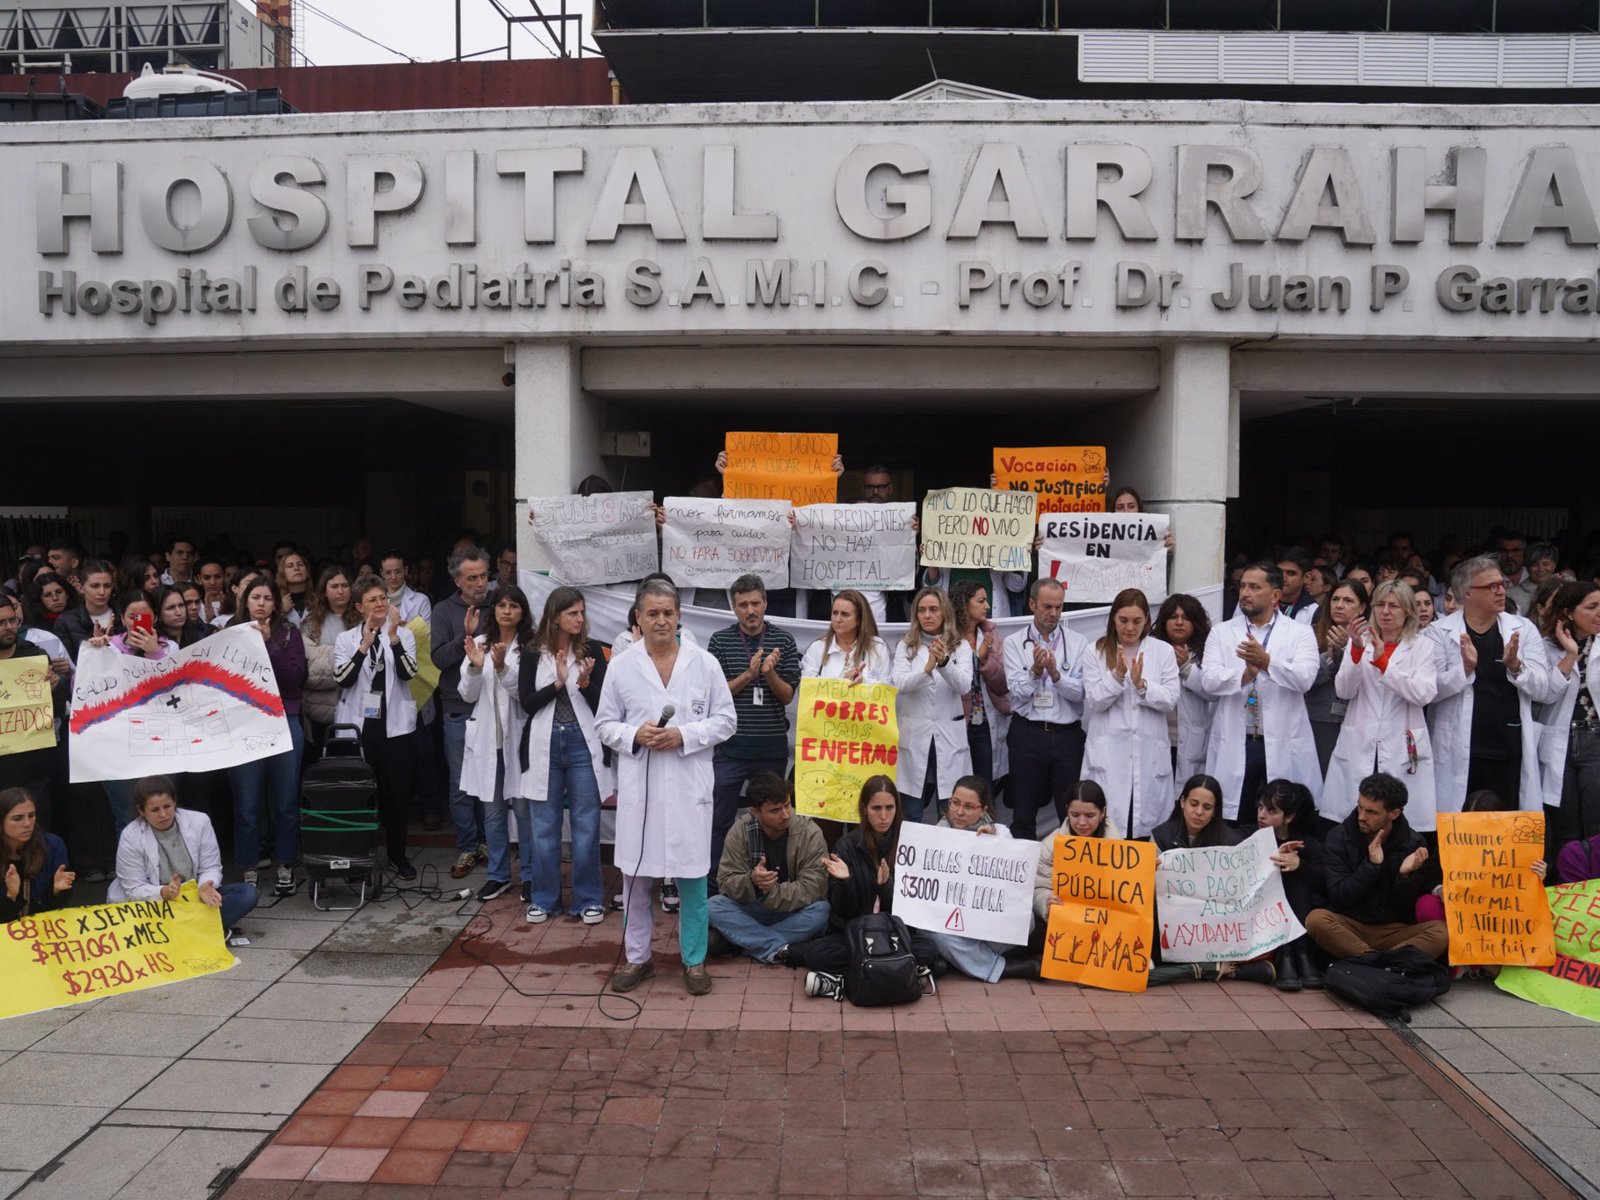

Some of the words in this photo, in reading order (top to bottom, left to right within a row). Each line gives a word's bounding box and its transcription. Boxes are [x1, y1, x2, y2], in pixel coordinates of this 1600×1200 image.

[37, 143, 777, 256] HOSPITAL
[38, 264, 257, 325] Hospital
[274, 264, 341, 312] de
[358, 258, 606, 311] Pediatria
[1210, 262, 1351, 312] Juan
[789, 434, 831, 456] DIGNOS
[730, 457, 757, 473] PARA
[808, 458, 822, 474] LA
[1000, 456, 1077, 473] Vocación
[1009, 480, 1029, 492] NO
[927, 491, 956, 510] AMO
[963, 492, 977, 512] LO
[980, 492, 1002, 513] QUE
[1004, 494, 1033, 515] HAGO
[1039, 497, 1101, 514] plotación
[798, 508, 824, 530] SIN
[833, 508, 906, 533] RESIDENTES
[938, 515, 969, 535] PERO
[972, 516, 989, 536] NO
[992, 517, 1020, 537] VIVO
[670, 546, 687, 560] NO
[691, 546, 719, 560] PARA
[811, 534, 837, 555] NO
[846, 535, 873, 552] HAY
[925, 539, 948, 561] CON
[952, 542, 967, 565] LO
[972, 543, 996, 567] QUE
[1085, 542, 1111, 559] EN
[802, 559, 890, 581] HOSPITAL
[76, 676, 118, 701] SALUD
[813, 700, 889, 725] POBRES
[801, 738, 898, 766] ENFERMO
[896, 844, 917, 867] 80
[923, 848, 963, 874] HORAS
[968, 854, 1029, 884] SEMANALES
[1063, 838, 1140, 870] SALUD
[1481, 848, 1524, 869] MAL
[1056, 872, 1144, 905] PÚBLICA
[1166, 879, 1196, 899] NO
[1449, 870, 1490, 883] como
[1491, 873, 1527, 890] MAL
[900, 872, 940, 902] $3000
[945, 881, 969, 907] POR
[971, 884, 1006, 913] HORA
[1488, 896, 1525, 913] MAL
[7, 920, 40, 940] 68
[42, 918, 69, 940] HS
[94, 900, 175, 931] SEMANA
[1084, 908, 1109, 925] EN
[133, 921, 170, 946] MES
[143, 951, 175, 974] HS
[1048, 929, 1148, 973] LLAMAS
